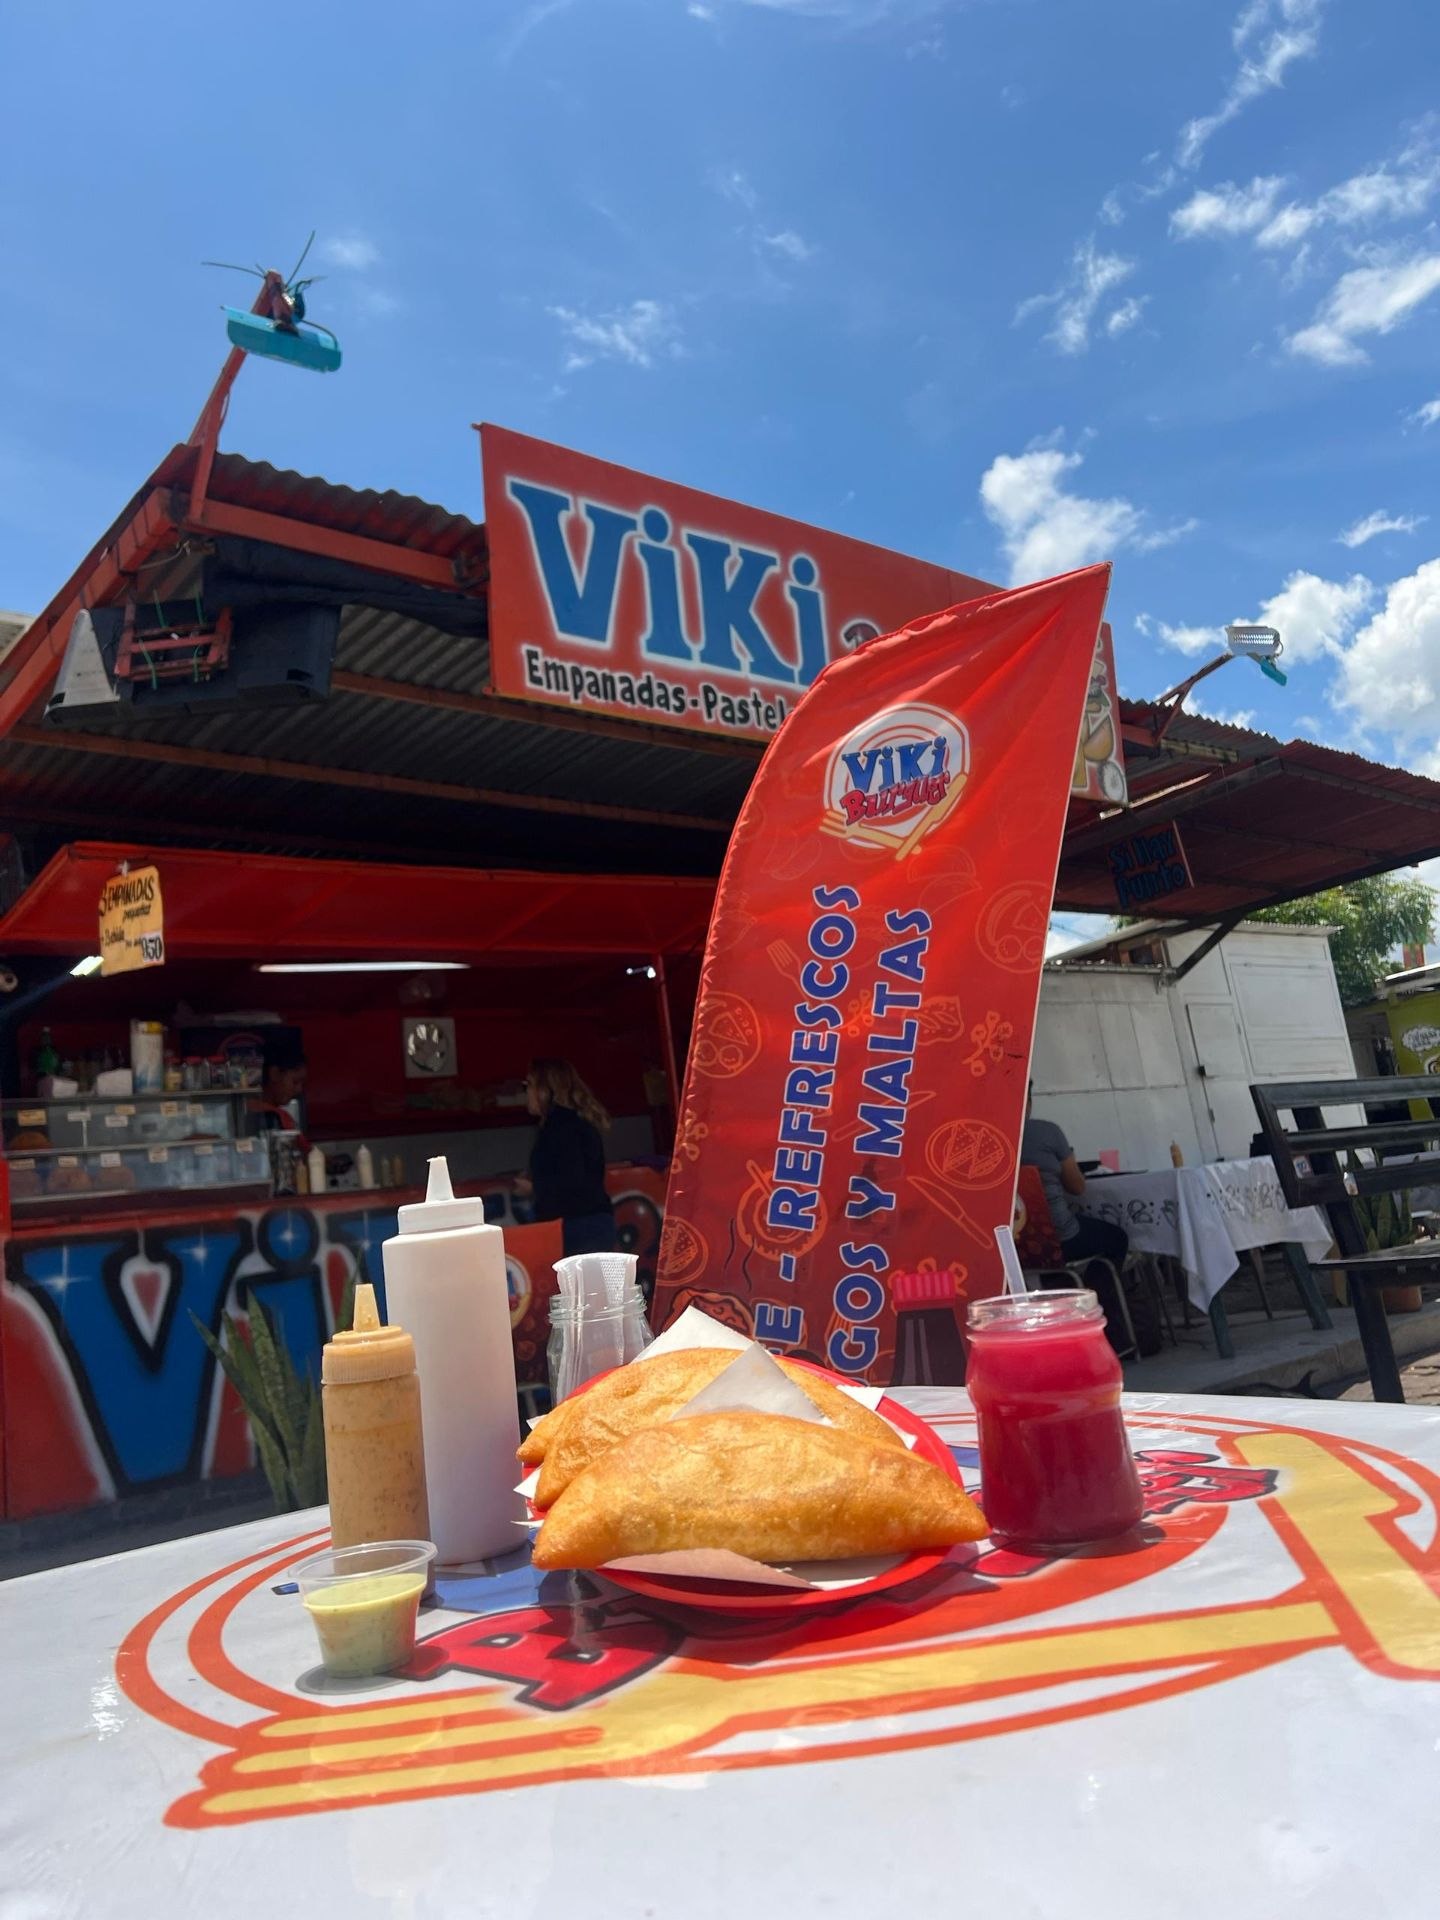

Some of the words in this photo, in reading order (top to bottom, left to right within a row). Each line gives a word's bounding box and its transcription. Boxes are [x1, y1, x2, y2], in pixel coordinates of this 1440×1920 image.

[842, 736, 947, 794] ViKi
[767, 885, 861, 1232] REFRESCOS
[853, 909, 932, 1157] MALTAS
[845, 1176, 896, 1219] Y
[827, 1242, 890, 1387] GOS
